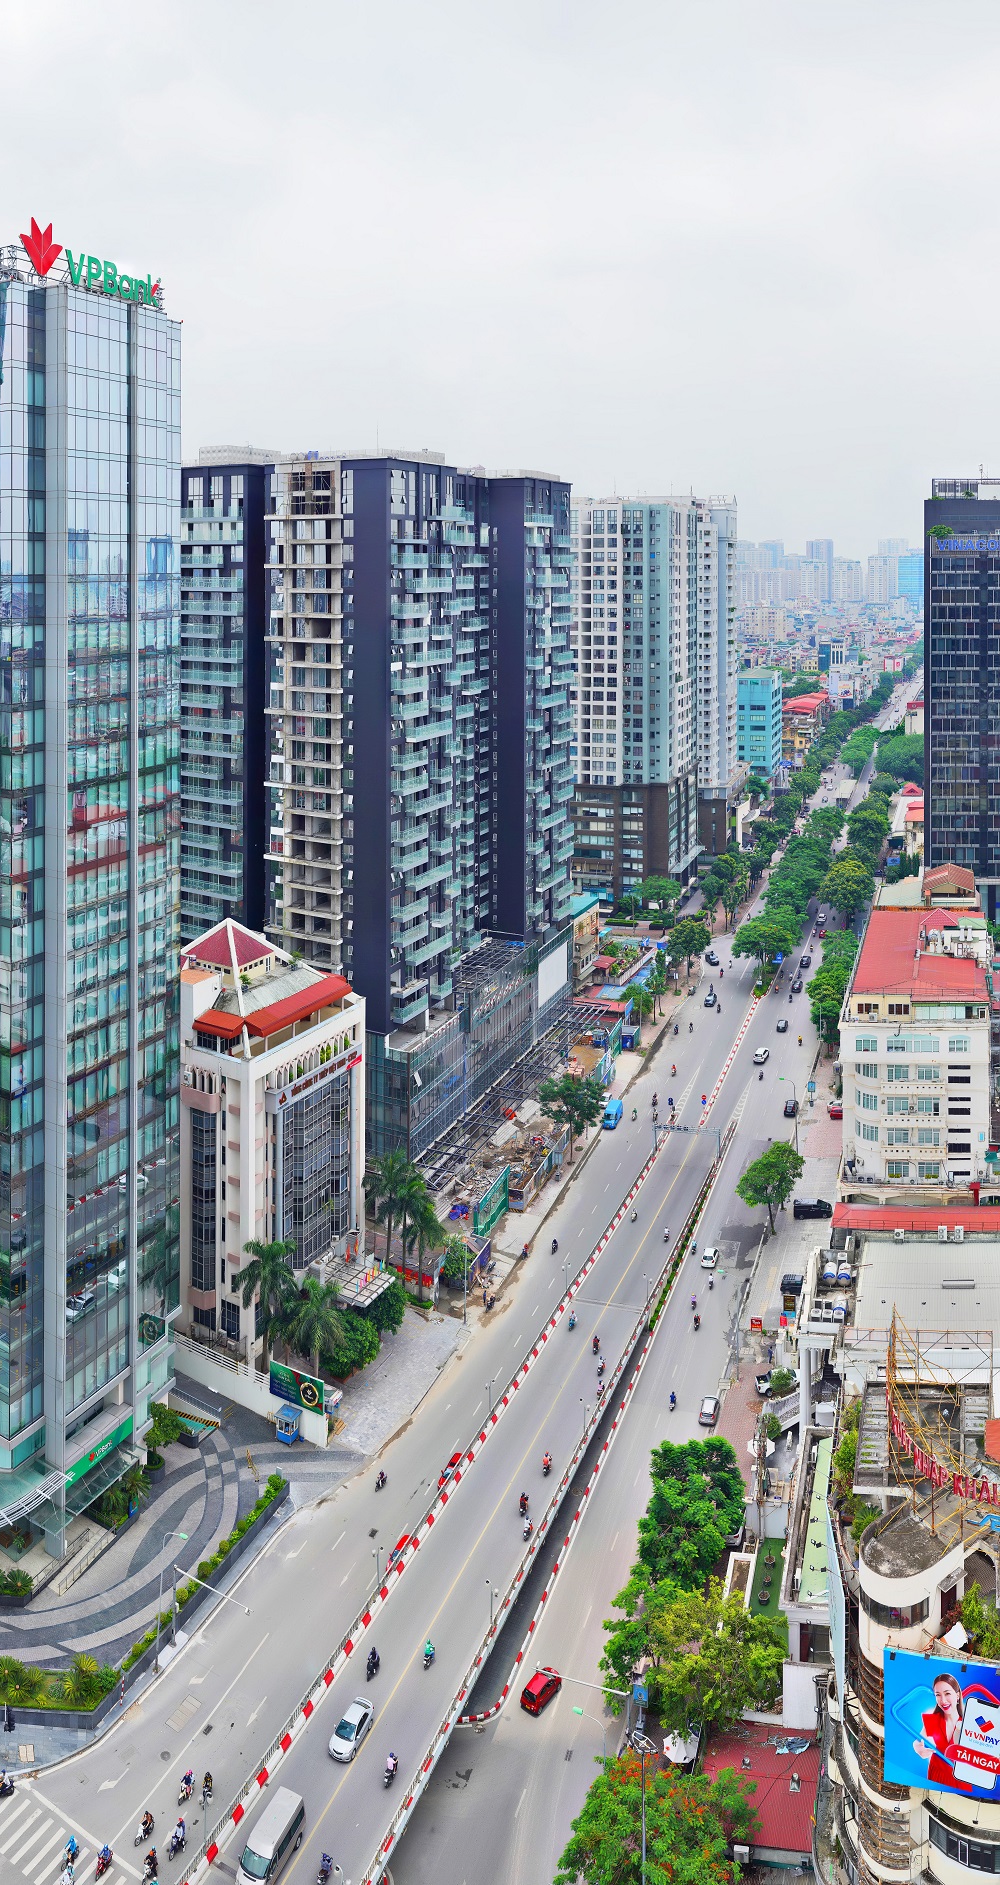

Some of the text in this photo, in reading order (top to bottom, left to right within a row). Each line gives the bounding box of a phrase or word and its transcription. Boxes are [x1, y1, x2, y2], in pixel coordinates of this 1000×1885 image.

[65, 249, 159, 307] VPBank
[935, 538, 1000, 551] VINACO
[974, 1732, 1000, 1745] VNPAY
[956, 1750, 999, 1770] TẢI NGAY
